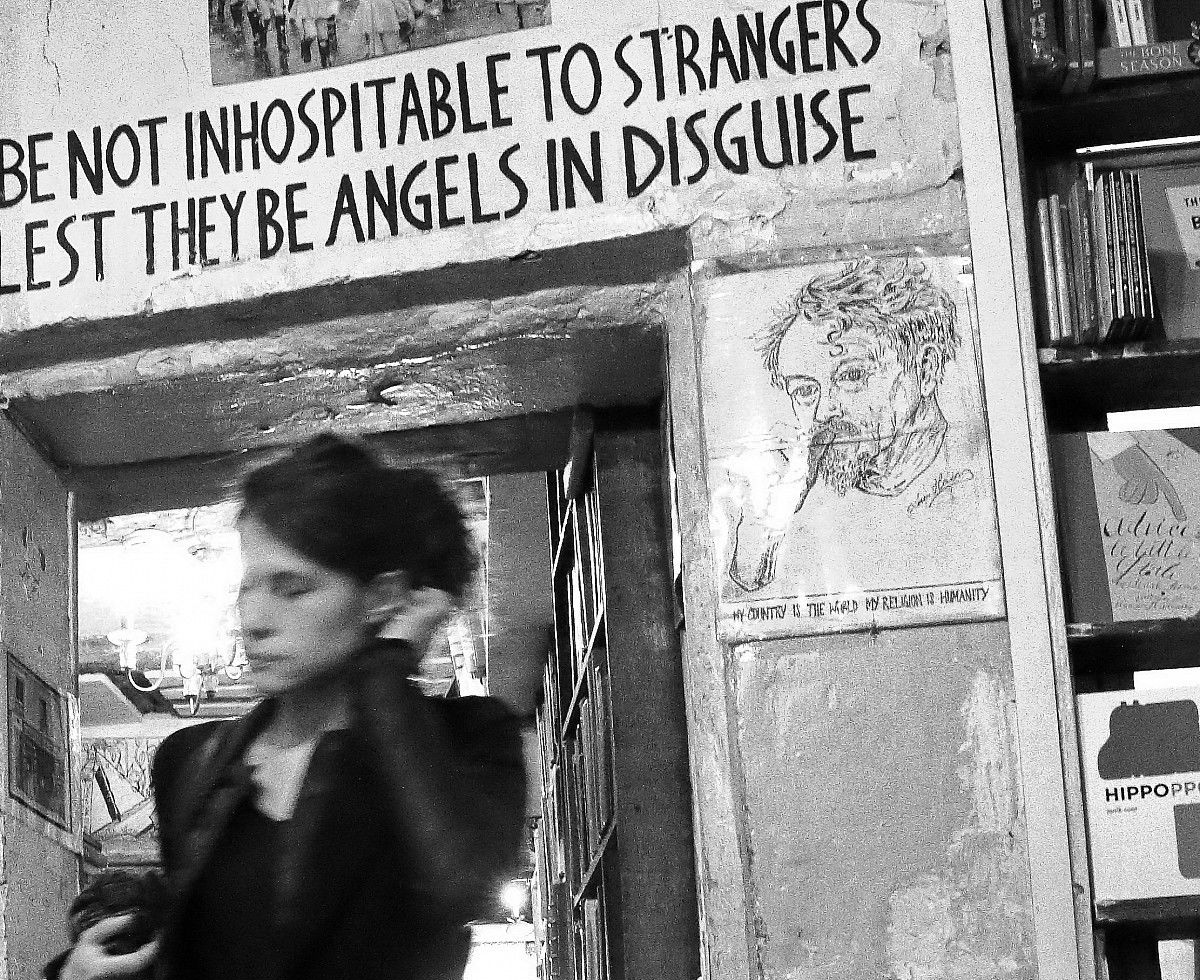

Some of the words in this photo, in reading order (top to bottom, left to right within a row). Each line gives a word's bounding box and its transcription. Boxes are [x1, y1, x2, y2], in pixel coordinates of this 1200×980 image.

[67, 116, 168, 199] NOT
[184, 52, 513, 181] INHOSPITABLE
[526, 42, 603, 123] TO
[614, 0, 881, 107] STRANGERS
[1120, 56, 1183, 74] SEASON
[131, 189, 247, 276] THEY
[256, 181, 314, 260] BE
[325, 142, 529, 247] ANGELS
[546, 130, 605, 212] IN
[621, 83, 877, 198] DISGUISE
[746, 604, 787, 622] COUNTRY
[792, 604, 802, 619] IS
[806, 601, 826, 618] THE
[865, 596, 880, 612] MY
[882, 592, 924, 611] RELIGION
[925, 592, 936, 607] IS
[939, 586, 990, 604] HUMANITY
